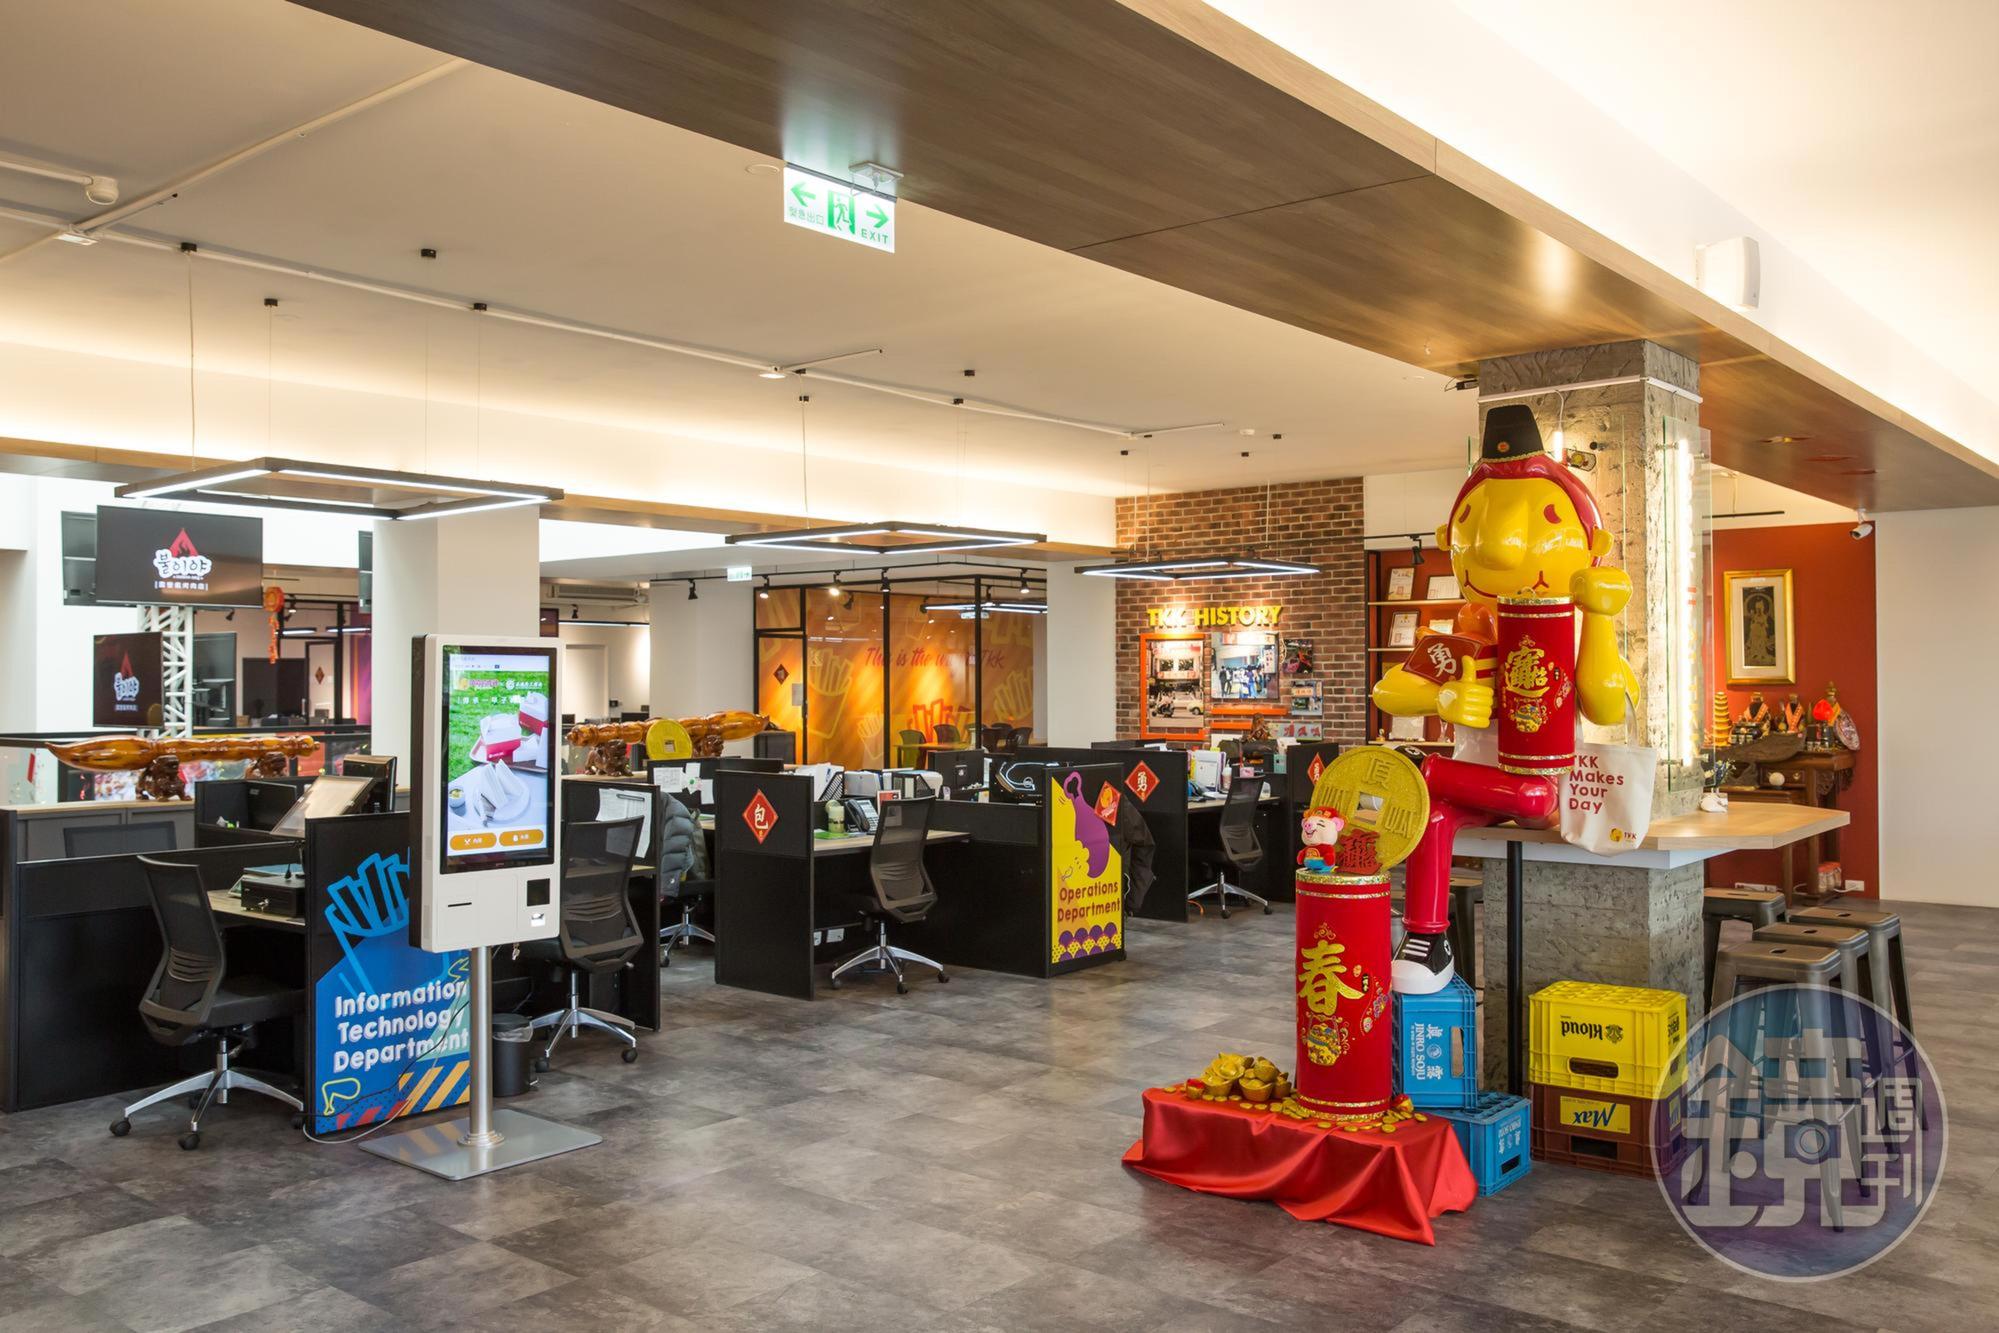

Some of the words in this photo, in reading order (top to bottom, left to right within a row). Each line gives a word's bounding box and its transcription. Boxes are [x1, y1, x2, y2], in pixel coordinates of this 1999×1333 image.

[861, 228, 889, 245] EXIT
[1194, 605, 1284, 627] HISTORY
[1427, 643, 1457, 678] 勇
[1574, 754, 1599, 769] KK
[1569, 769, 1624, 785] Makes
[1569, 783, 1608, 798] Your
[754, 803, 769, 830] 包
[1569, 798, 1603, 814] Day
[1059, 880, 1119, 904] Operations
[1057, 900, 1121, 923] Department
[1298, 939, 1365, 1016] 春
[335, 979, 469, 1018] Information
[337, 1008, 465, 1045] Technology
[1414, 1022, 1425, 1053] JINRO
[1560, 1019, 1603, 1041] Kloud
[333, 1028, 470, 1074] Department
[1415, 1054, 1426, 1081] SOJU
[1572, 1102, 1617, 1128] Max
